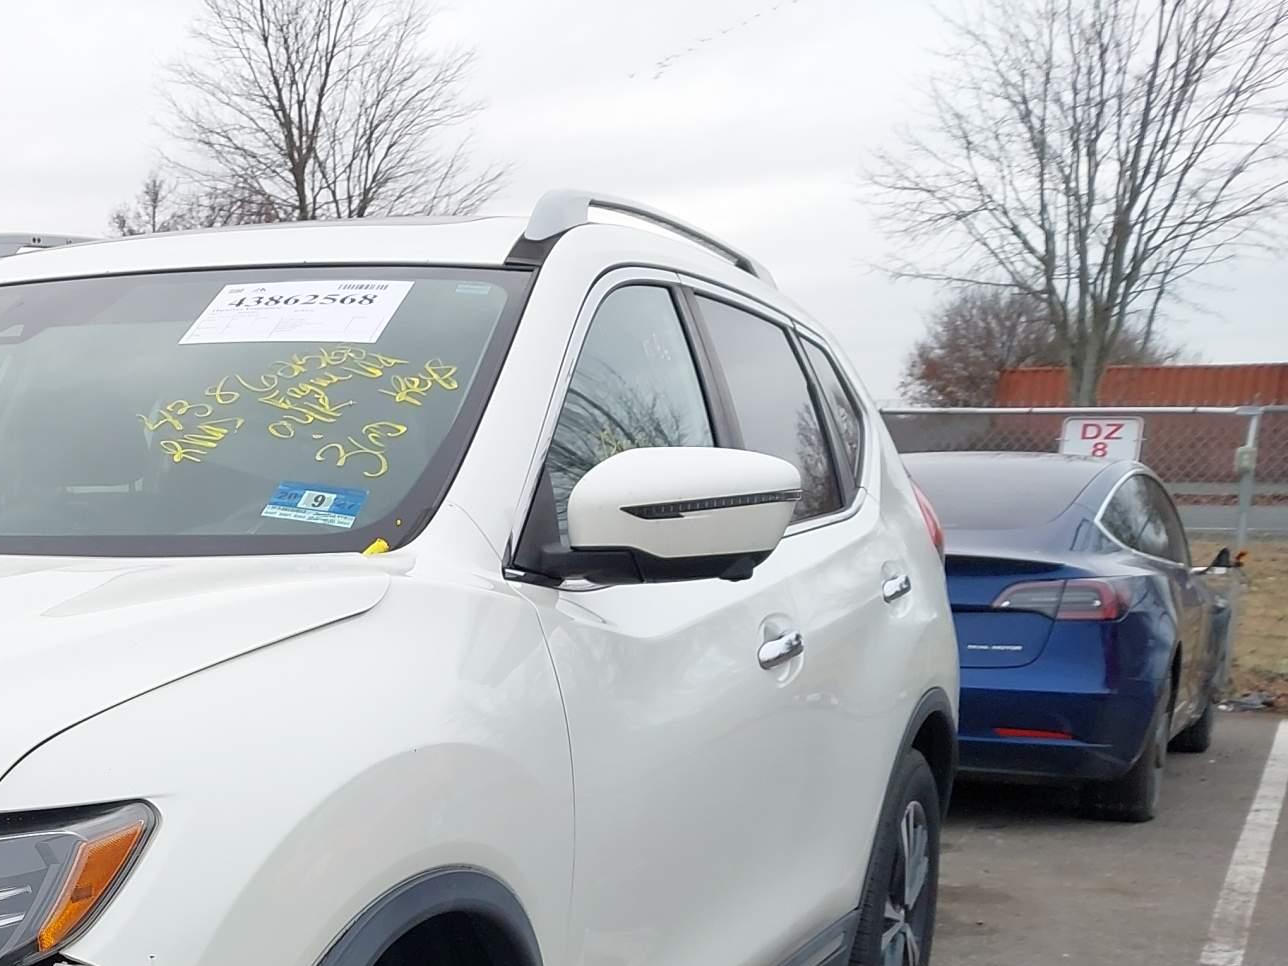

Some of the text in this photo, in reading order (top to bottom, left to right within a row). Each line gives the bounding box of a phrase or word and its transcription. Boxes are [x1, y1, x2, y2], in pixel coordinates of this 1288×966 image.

[228, 293, 379, 309] 43862568
[1080, 423, 1125, 440] DZ
[1091, 441, 1109, 458] 8
[311, 494, 326, 508] 9
